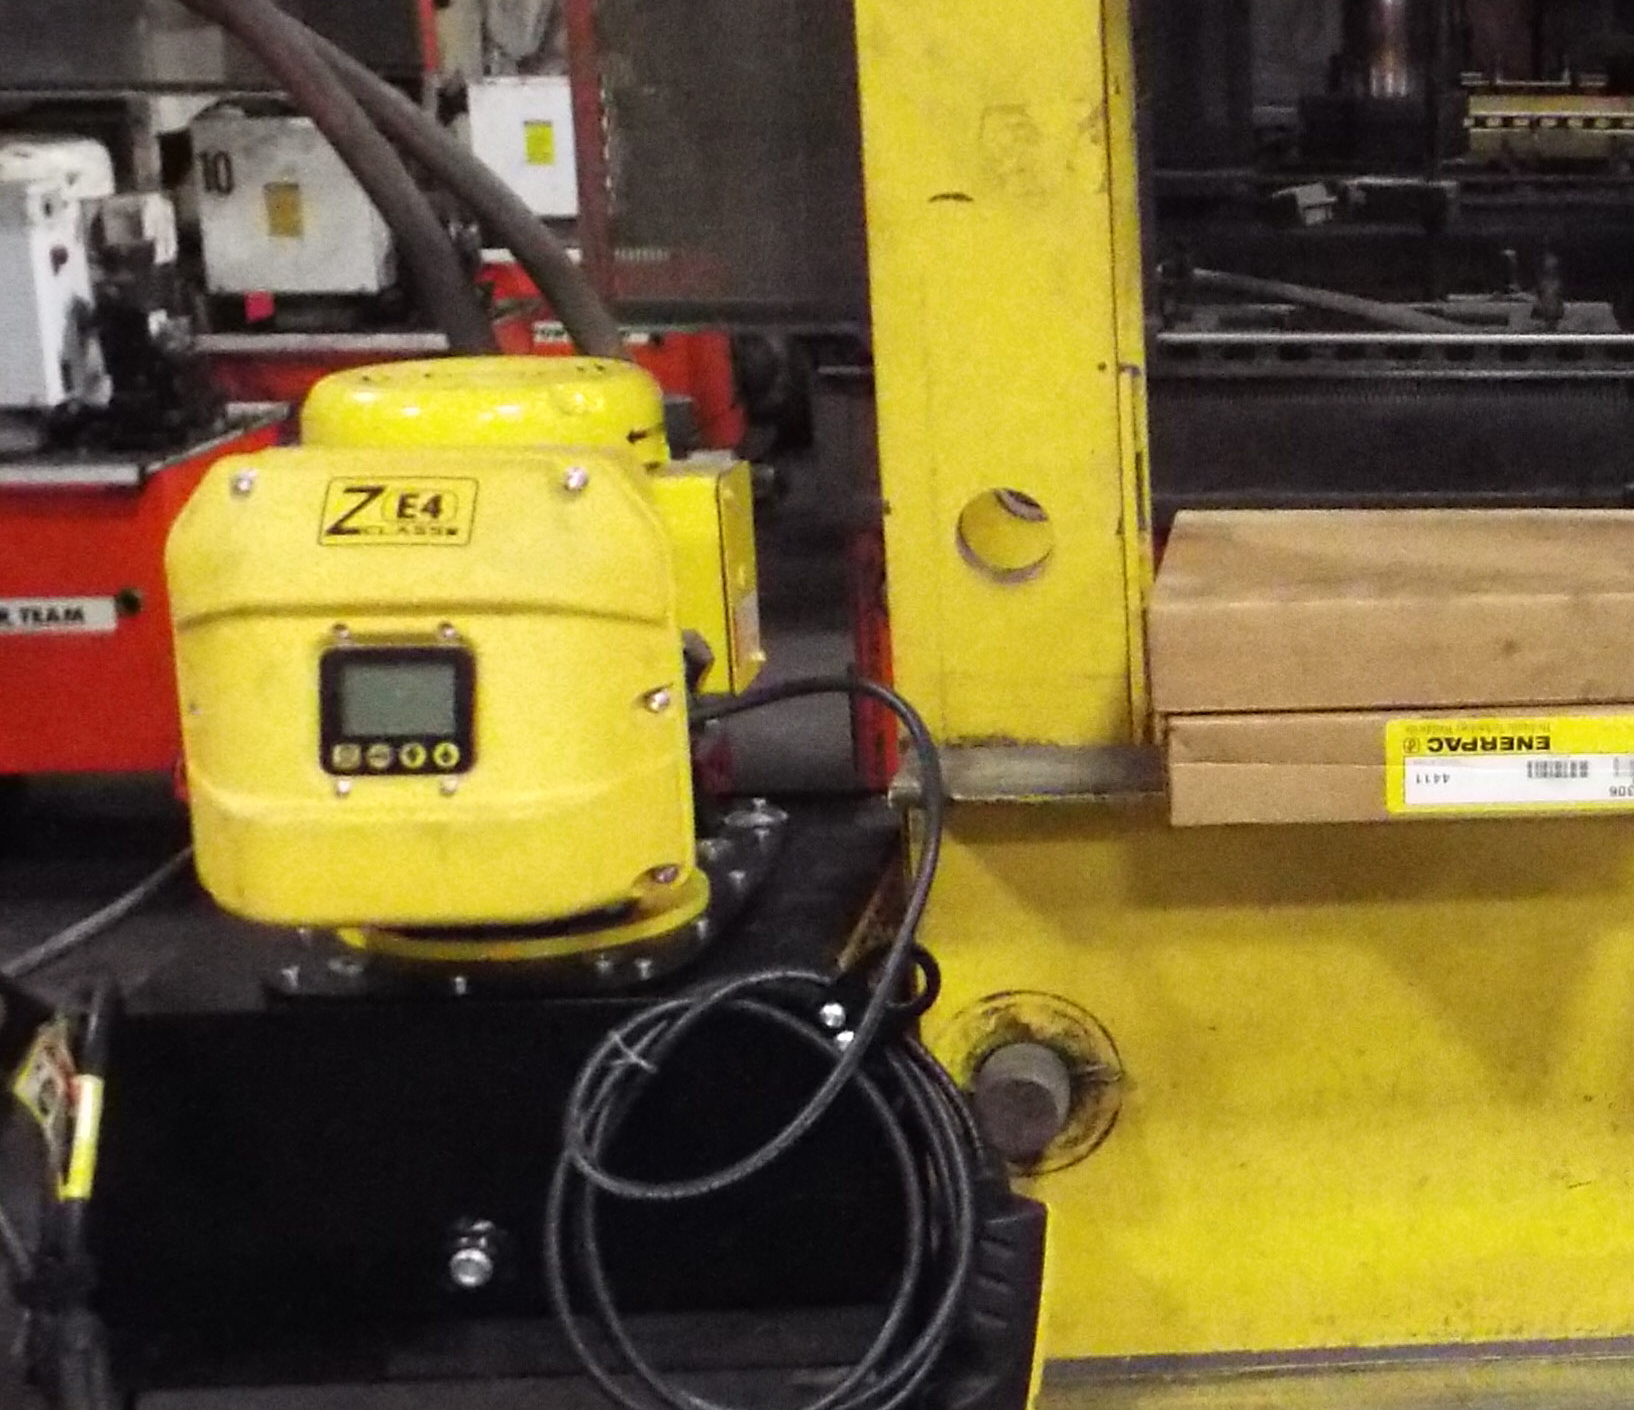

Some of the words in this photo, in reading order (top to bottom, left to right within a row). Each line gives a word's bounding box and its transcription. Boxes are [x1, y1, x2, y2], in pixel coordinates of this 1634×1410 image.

[199, 151, 235, 195] 10
[396, 491, 443, 519] E4
[19, 605, 85, 622] TEAM
[1426, 735, 1551, 752] ENERPAC
